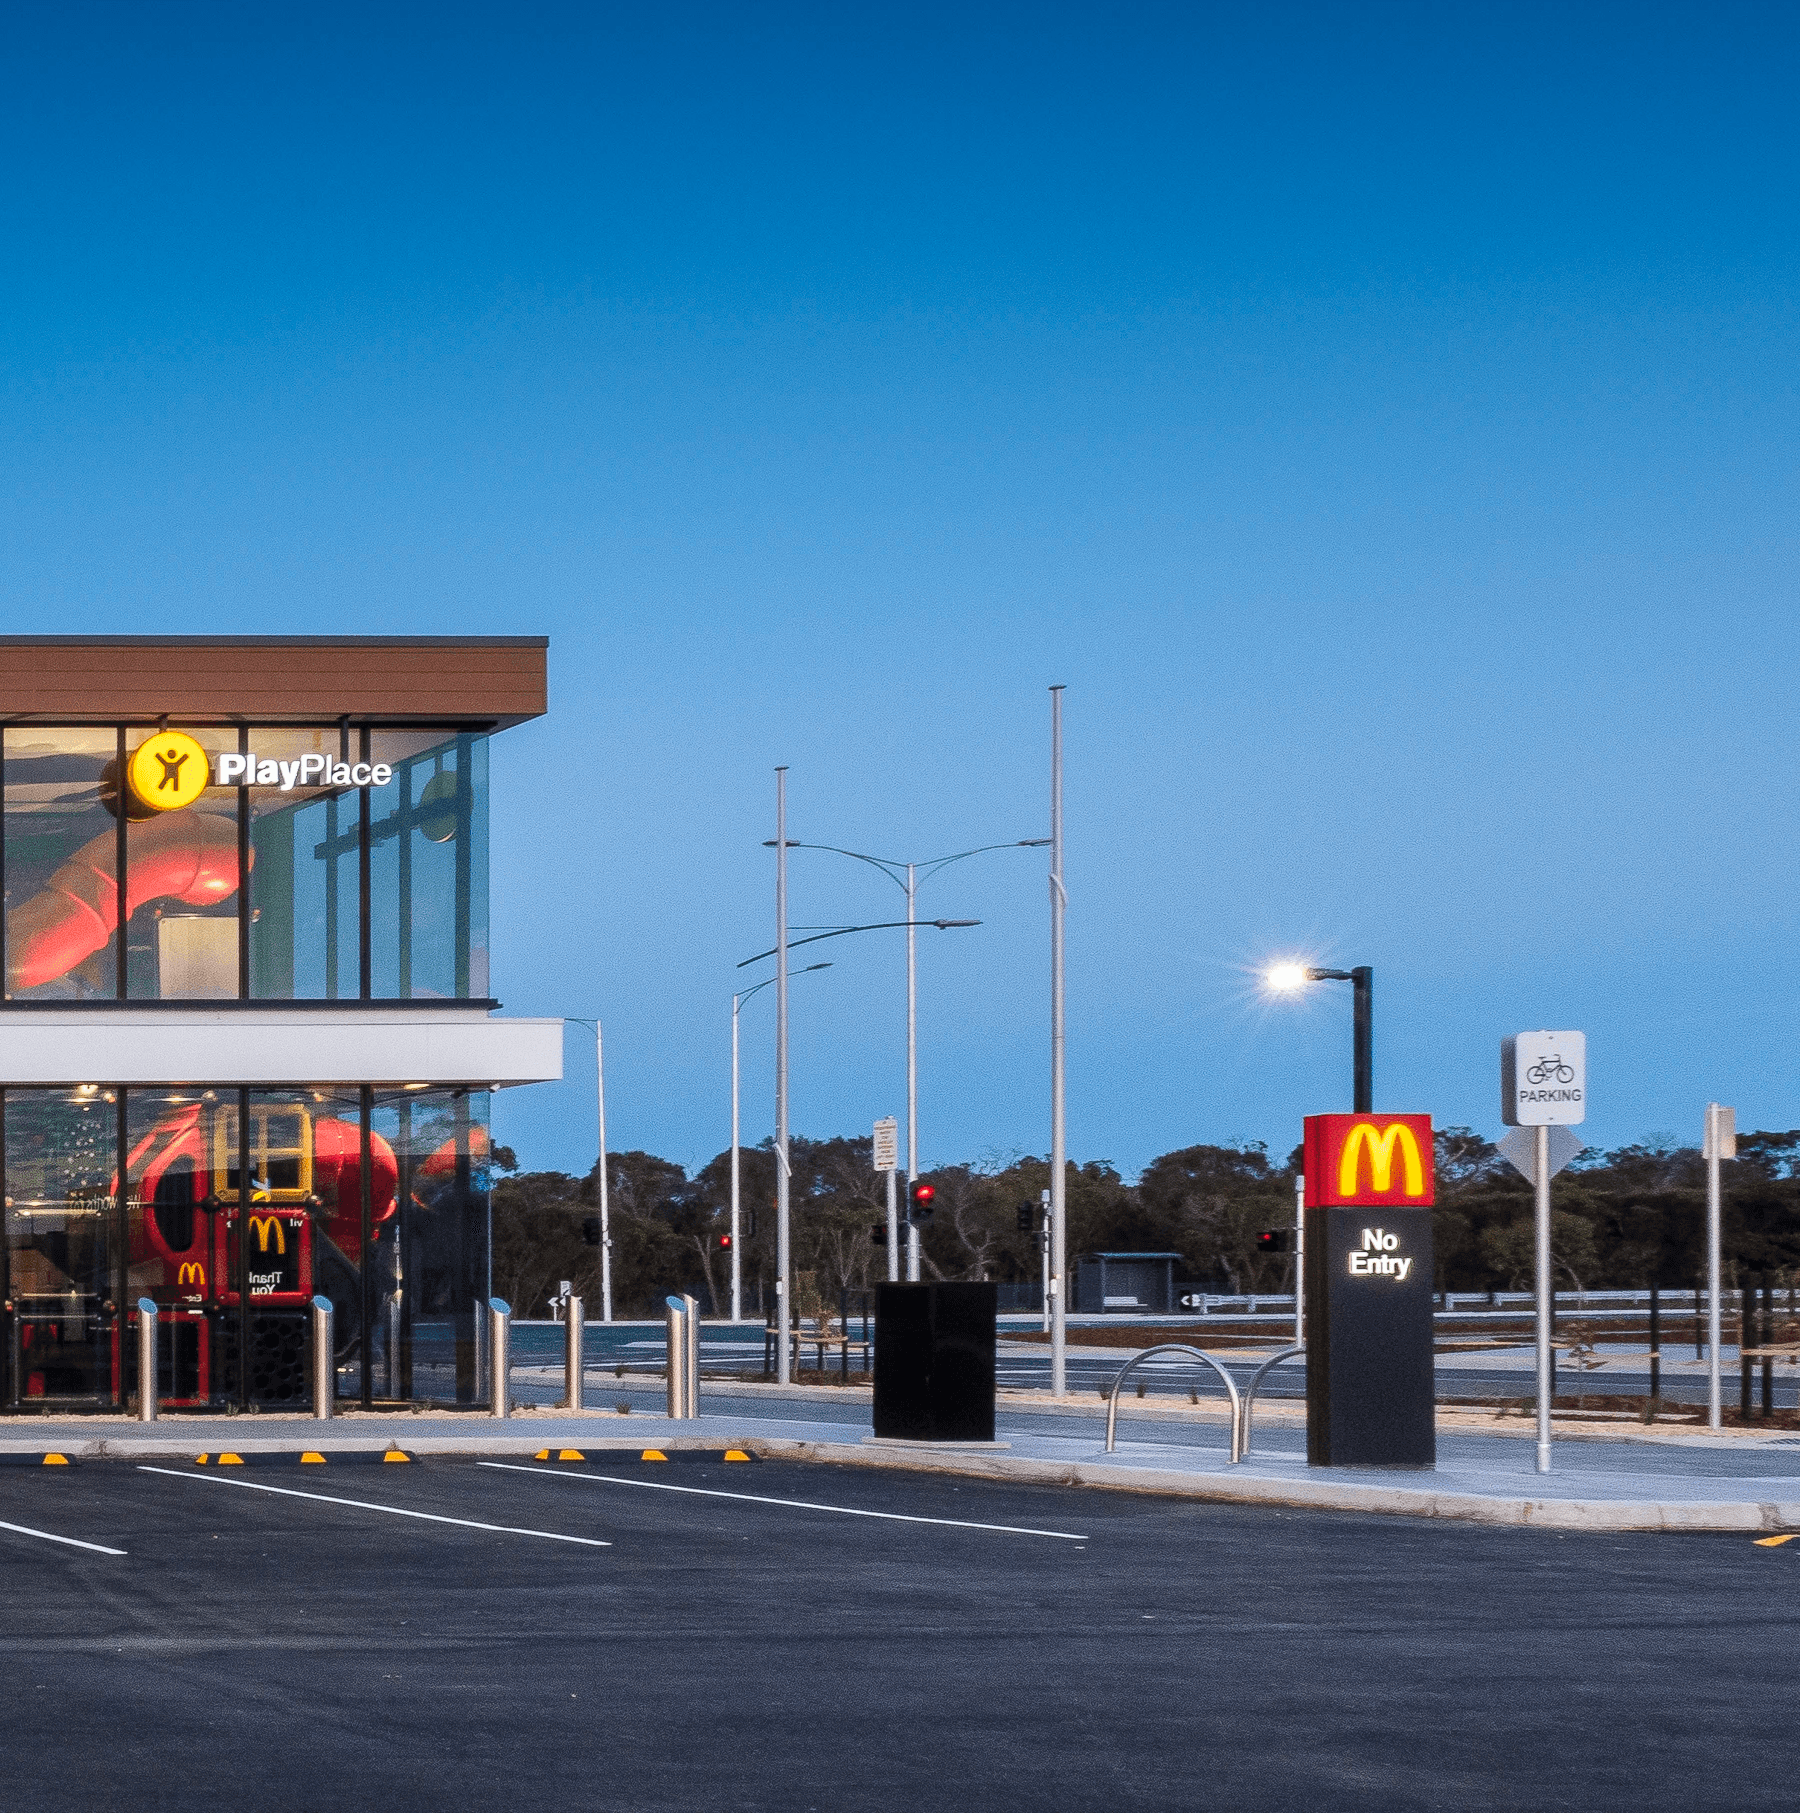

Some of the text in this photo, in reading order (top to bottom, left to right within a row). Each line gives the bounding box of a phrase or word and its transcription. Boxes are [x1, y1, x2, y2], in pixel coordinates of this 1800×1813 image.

[219, 753, 393, 791] PlayPlace
[1519, 1089, 1582, 1102] PARKING
[1362, 1228, 1399, 1251] No
[1349, 1251, 1413, 1280] Entry
